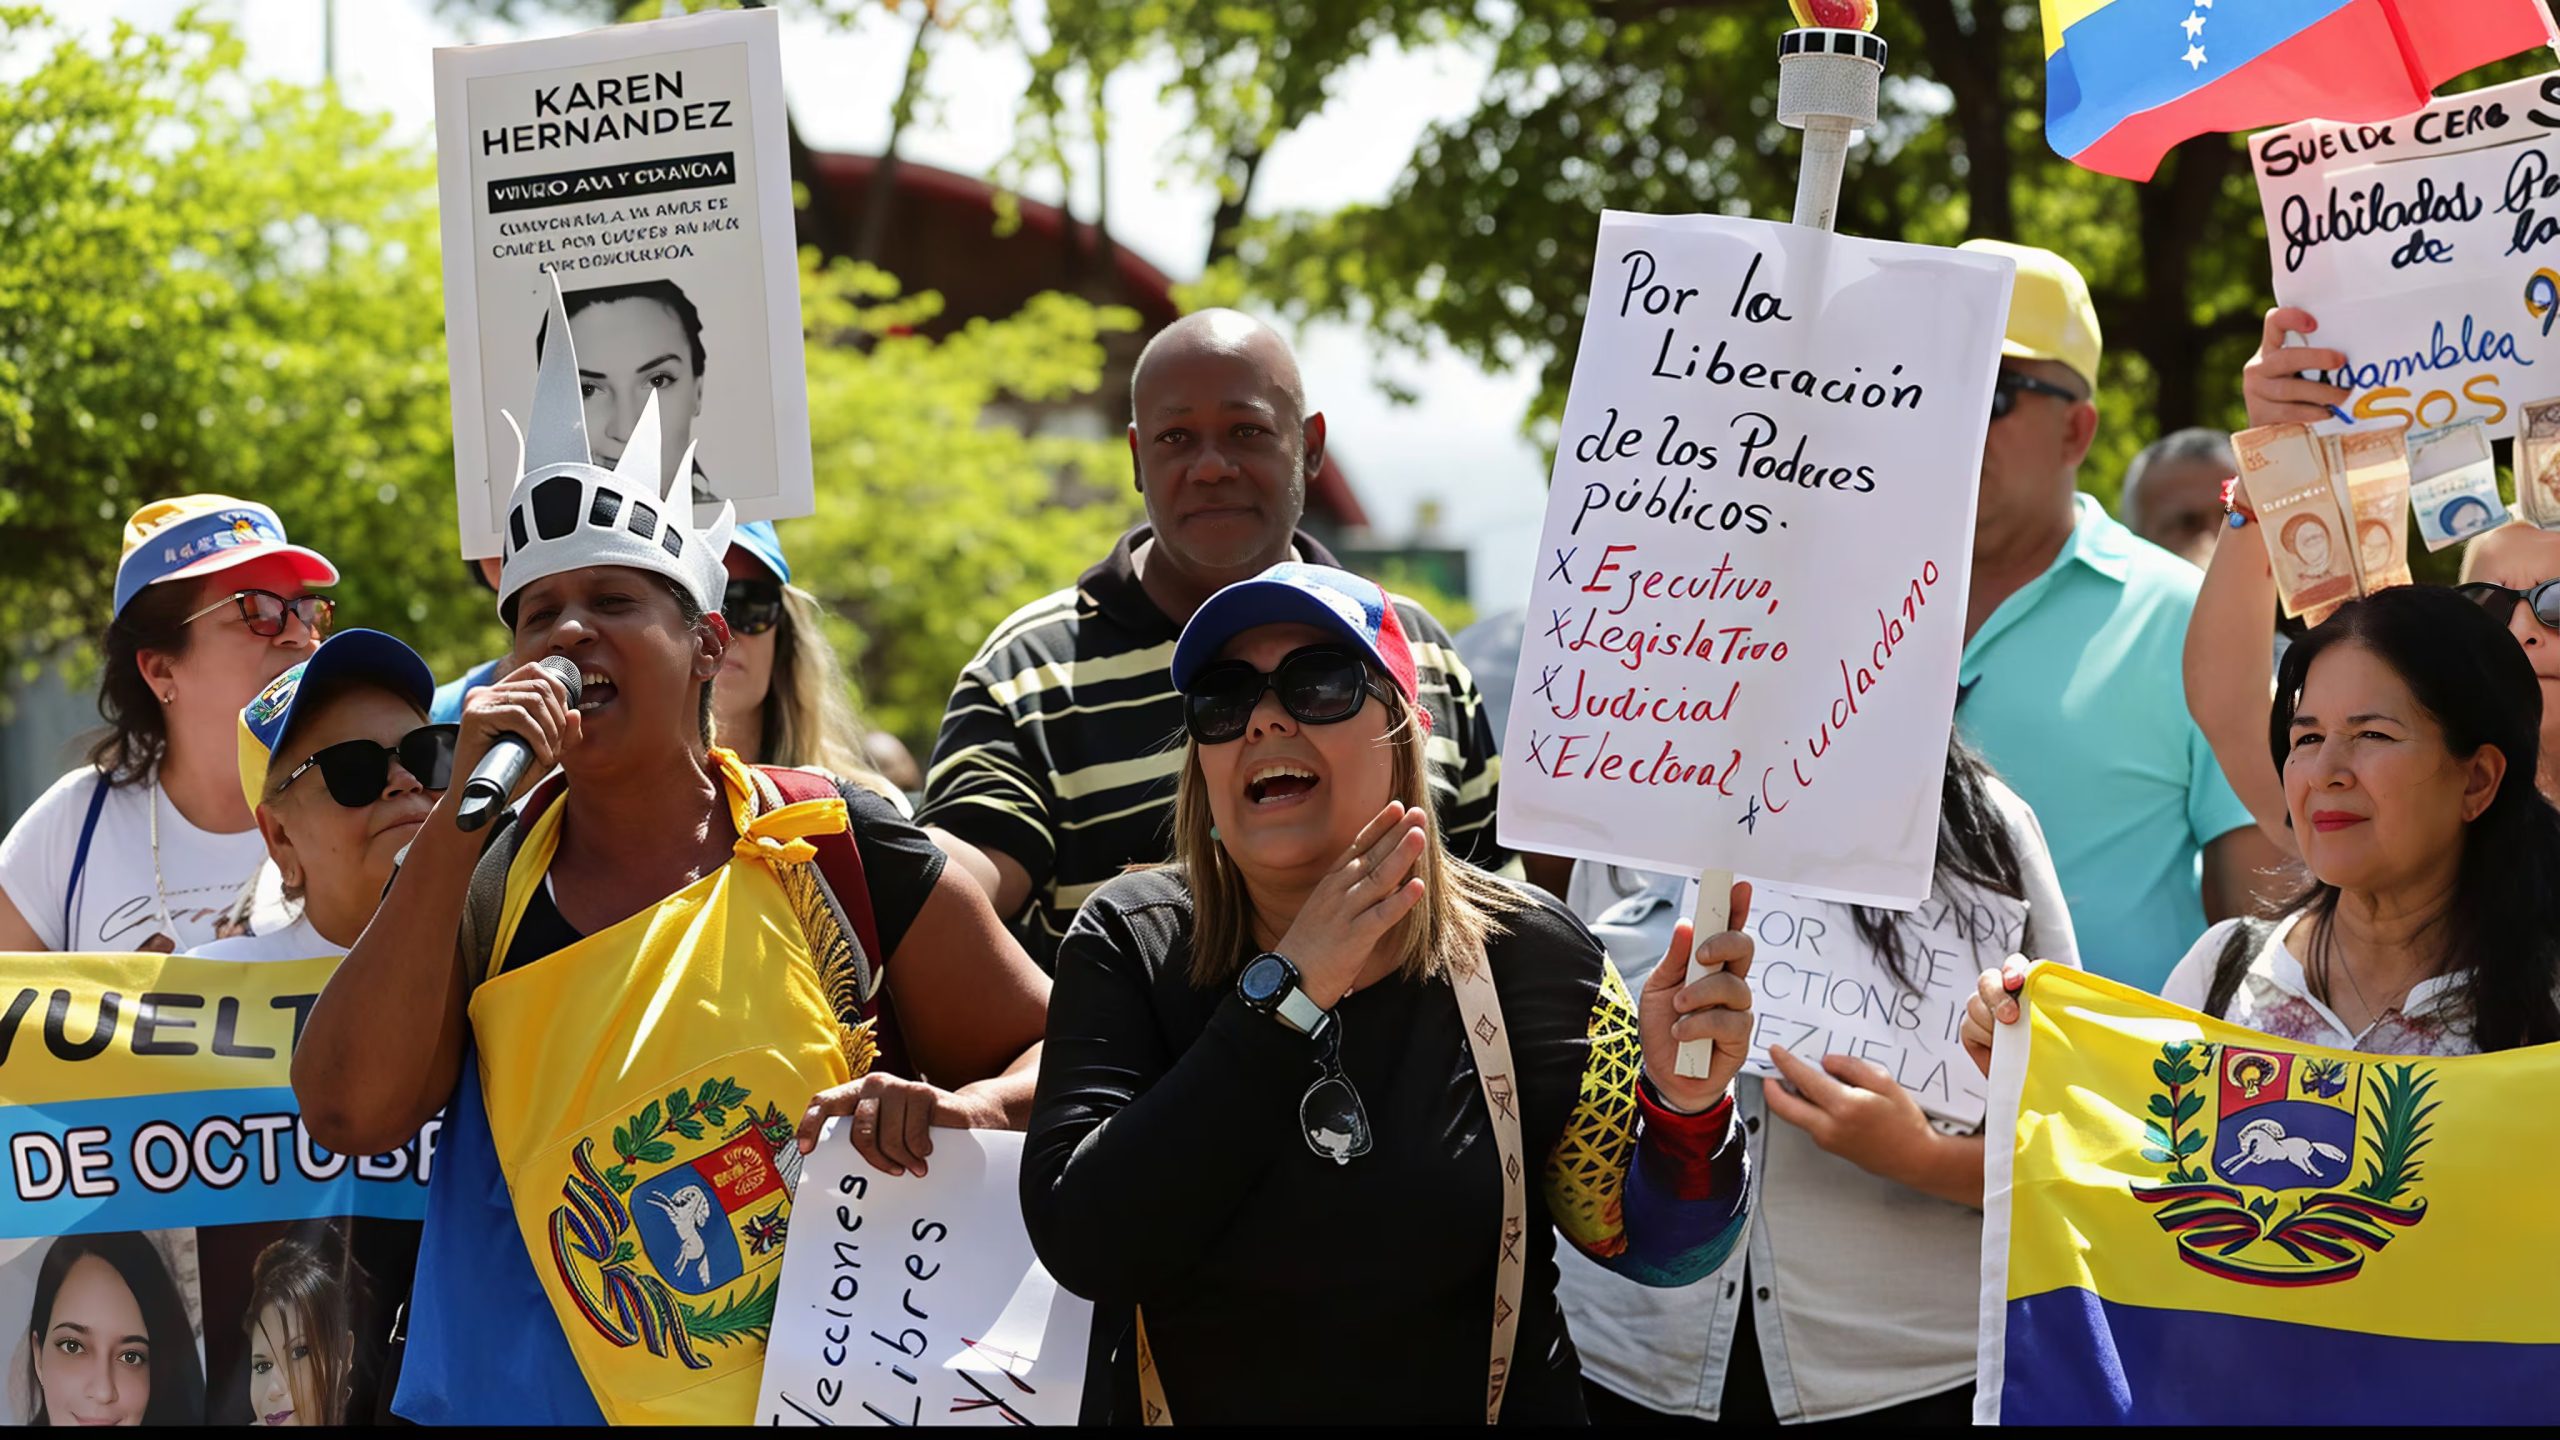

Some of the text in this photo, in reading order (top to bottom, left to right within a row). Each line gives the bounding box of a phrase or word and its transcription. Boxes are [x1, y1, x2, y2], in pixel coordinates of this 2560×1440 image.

[535, 71, 684, 117] KAREN
[2526, 76, 2560, 129] S
[483, 101, 733, 156] HERNANDEZ
[2281, 177, 2483, 273] Jubilados
[2391, 229, 2455, 269] de
[1621, 250, 1793, 323] Por la
[1652, 328, 1923, 410] Liberación
[2353, 374, 2507, 431] SOS
[1576, 408, 1876, 494] de los Poderes
[1571, 477, 1789, 536] públicos.
[1552, 669, 1742, 722] Judicial
[1552, 732, 1743, 797] Electoral
[1747, 908, 1826, 957] OR
[1746, 960, 1922, 1031] CTIONS
[10, 1126, 121, 1202] DE
[773, 1173, 868, 1426] lecciones
[863, 1218, 948, 1426] Libres
